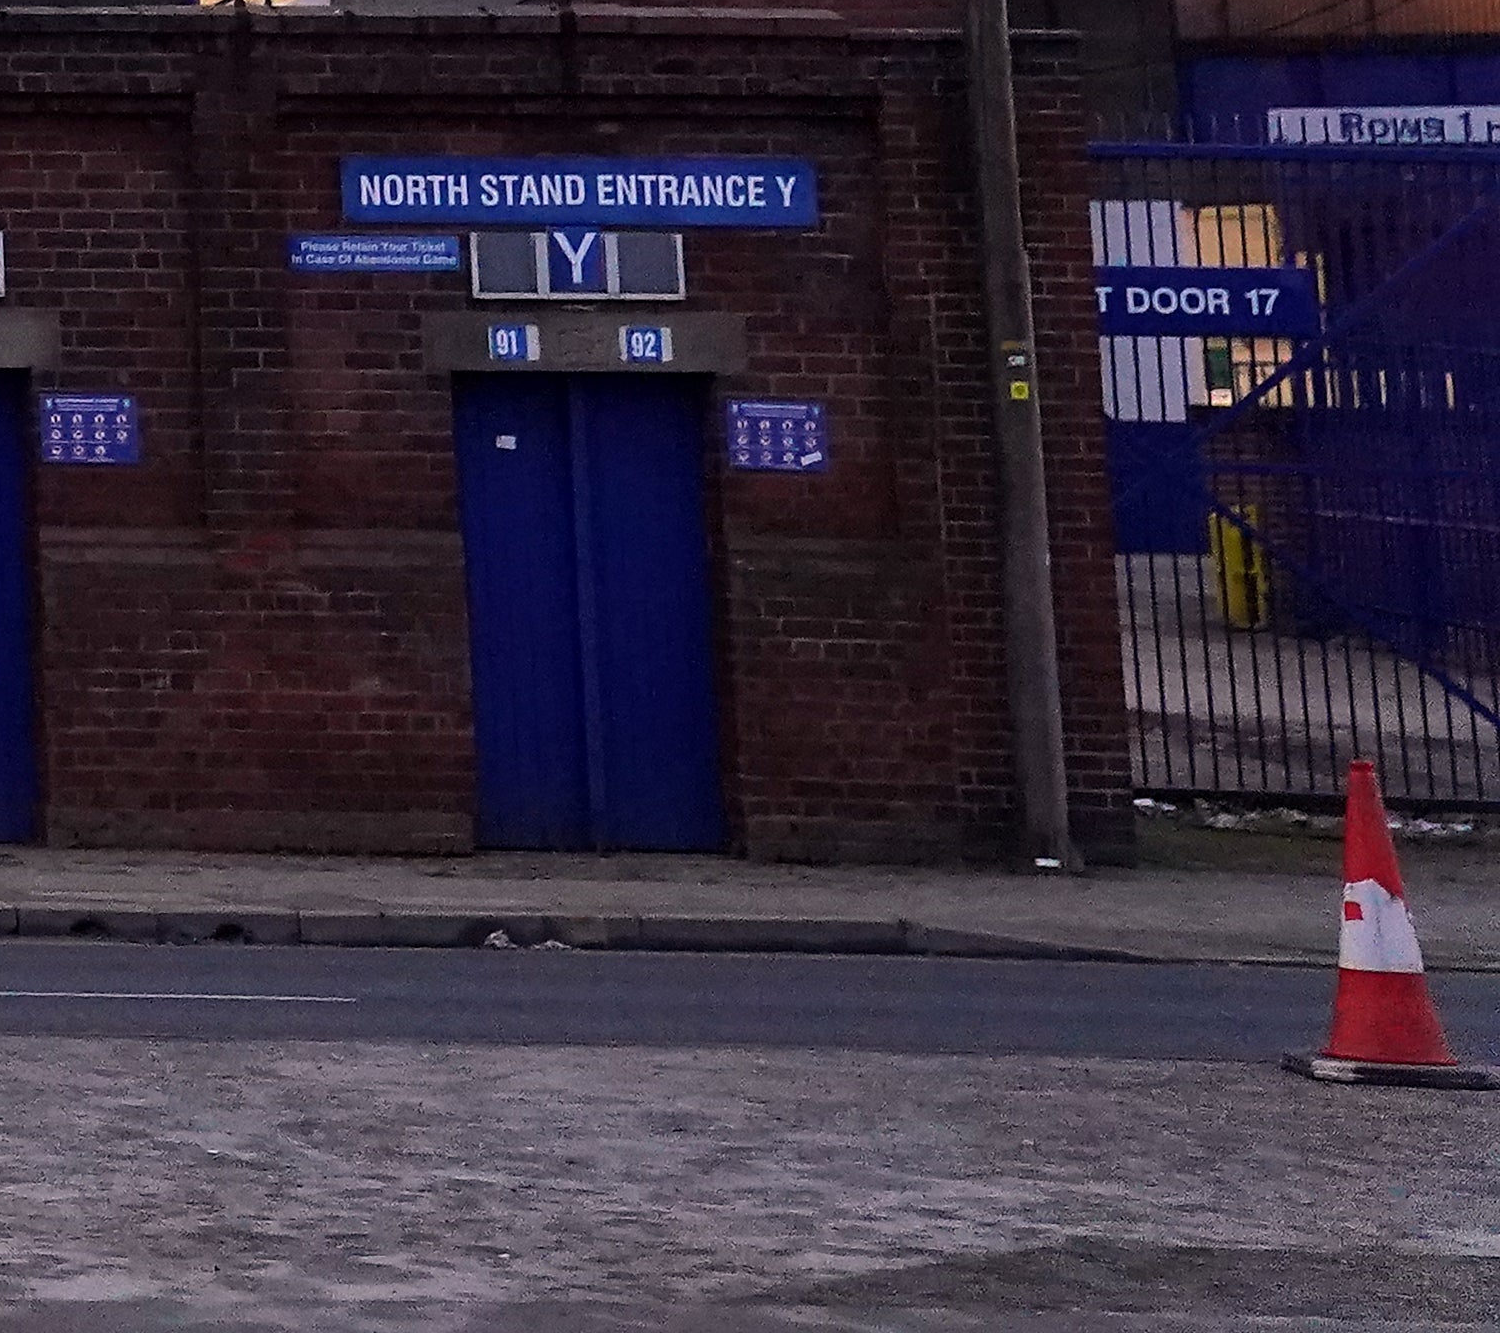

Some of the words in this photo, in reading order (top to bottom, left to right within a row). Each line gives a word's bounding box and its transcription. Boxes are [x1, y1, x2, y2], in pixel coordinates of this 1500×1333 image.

[360, 175, 468, 205] NORTH
[481, 175, 585, 206] STAND
[598, 175, 766, 206] ENTRANCE
[775, 177, 796, 207] Y
[553, 233, 598, 284] Y
[1126, 287, 1230, 314] DOOR
[1245, 288, 1280, 315] 17
[497, 331, 518, 356] 91
[632, 333, 656, 357] 92
